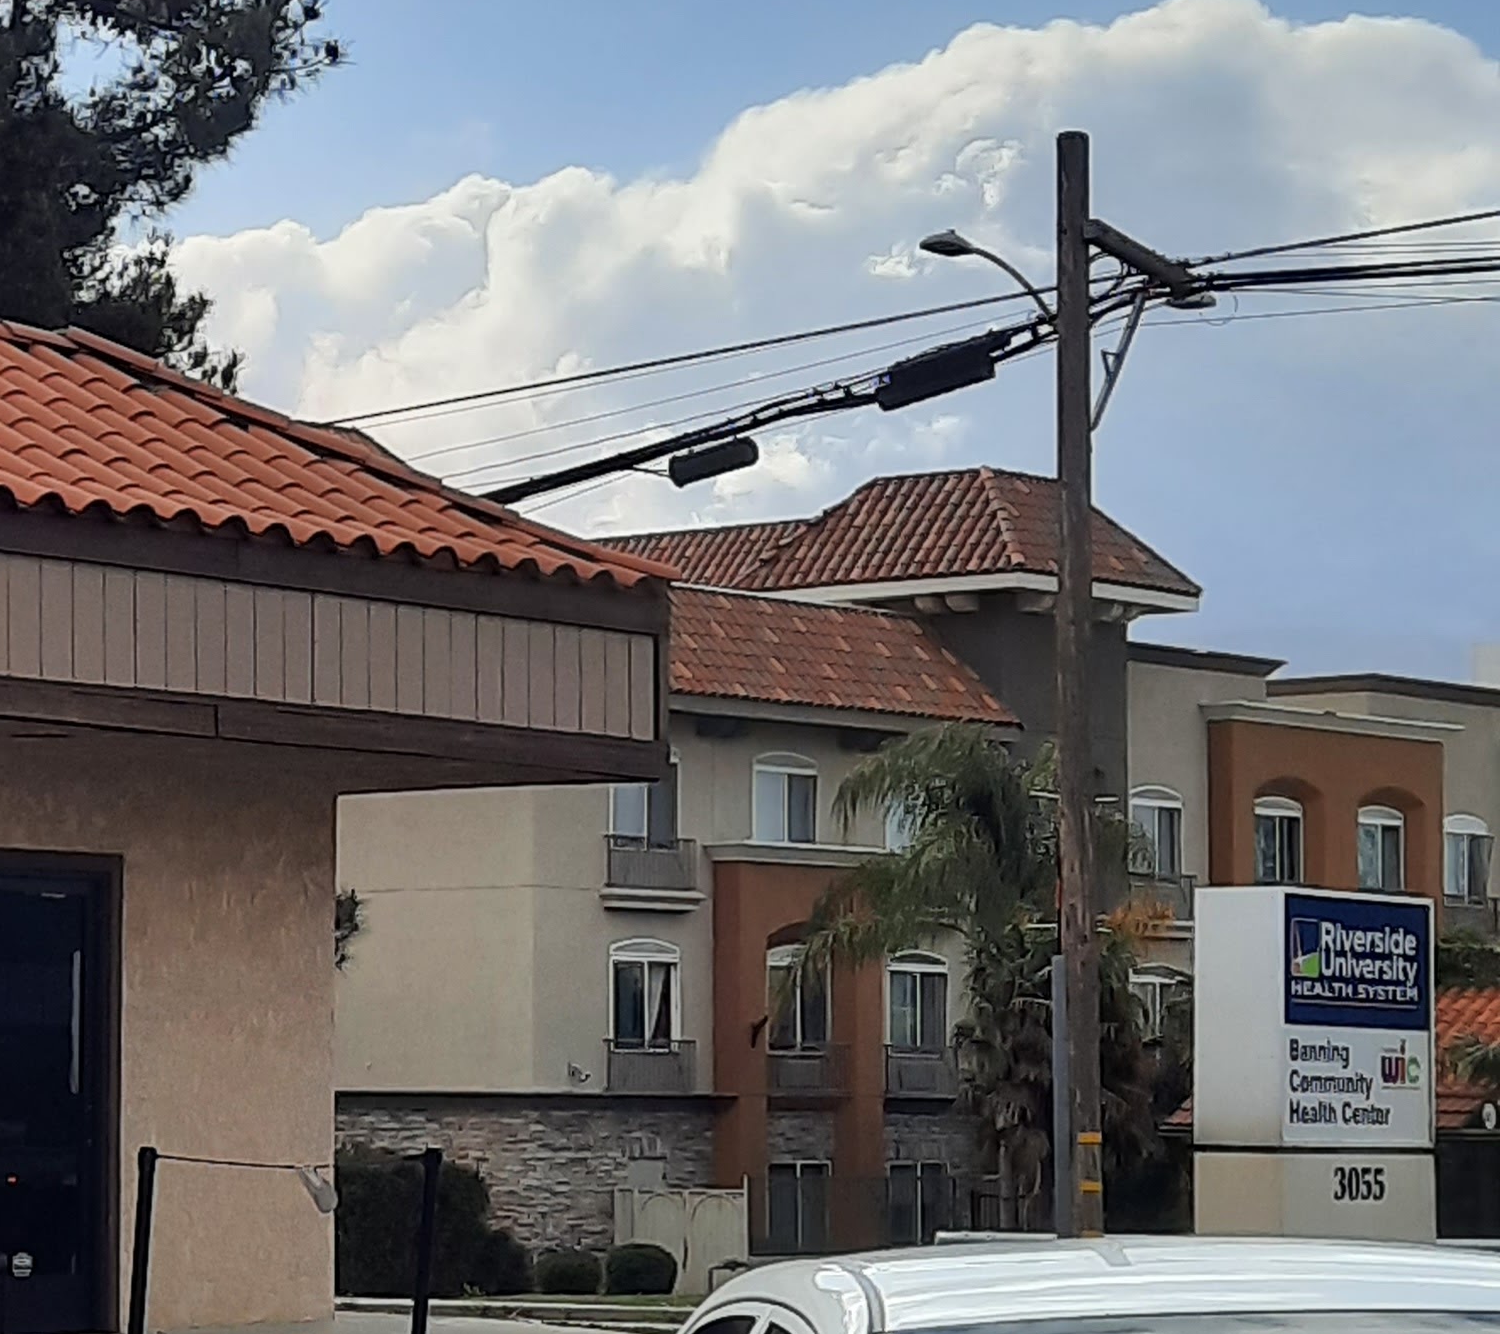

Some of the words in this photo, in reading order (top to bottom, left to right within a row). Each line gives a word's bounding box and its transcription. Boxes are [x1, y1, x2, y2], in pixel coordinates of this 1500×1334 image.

[1320, 921, 1417, 956] Riverside
[1320, 950, 1418, 987] University
[1291, 979, 1353, 998] HEALTH
[1357, 984, 1418, 1002] SYSTEM
[1289, 1037, 1350, 1069] Banning
[1289, 1069, 1373, 1101] Community
[1289, 1099, 1338, 1124] Health
[1341, 1101, 1391, 1125] Center
[1332, 1167, 1386, 1201] 3055
